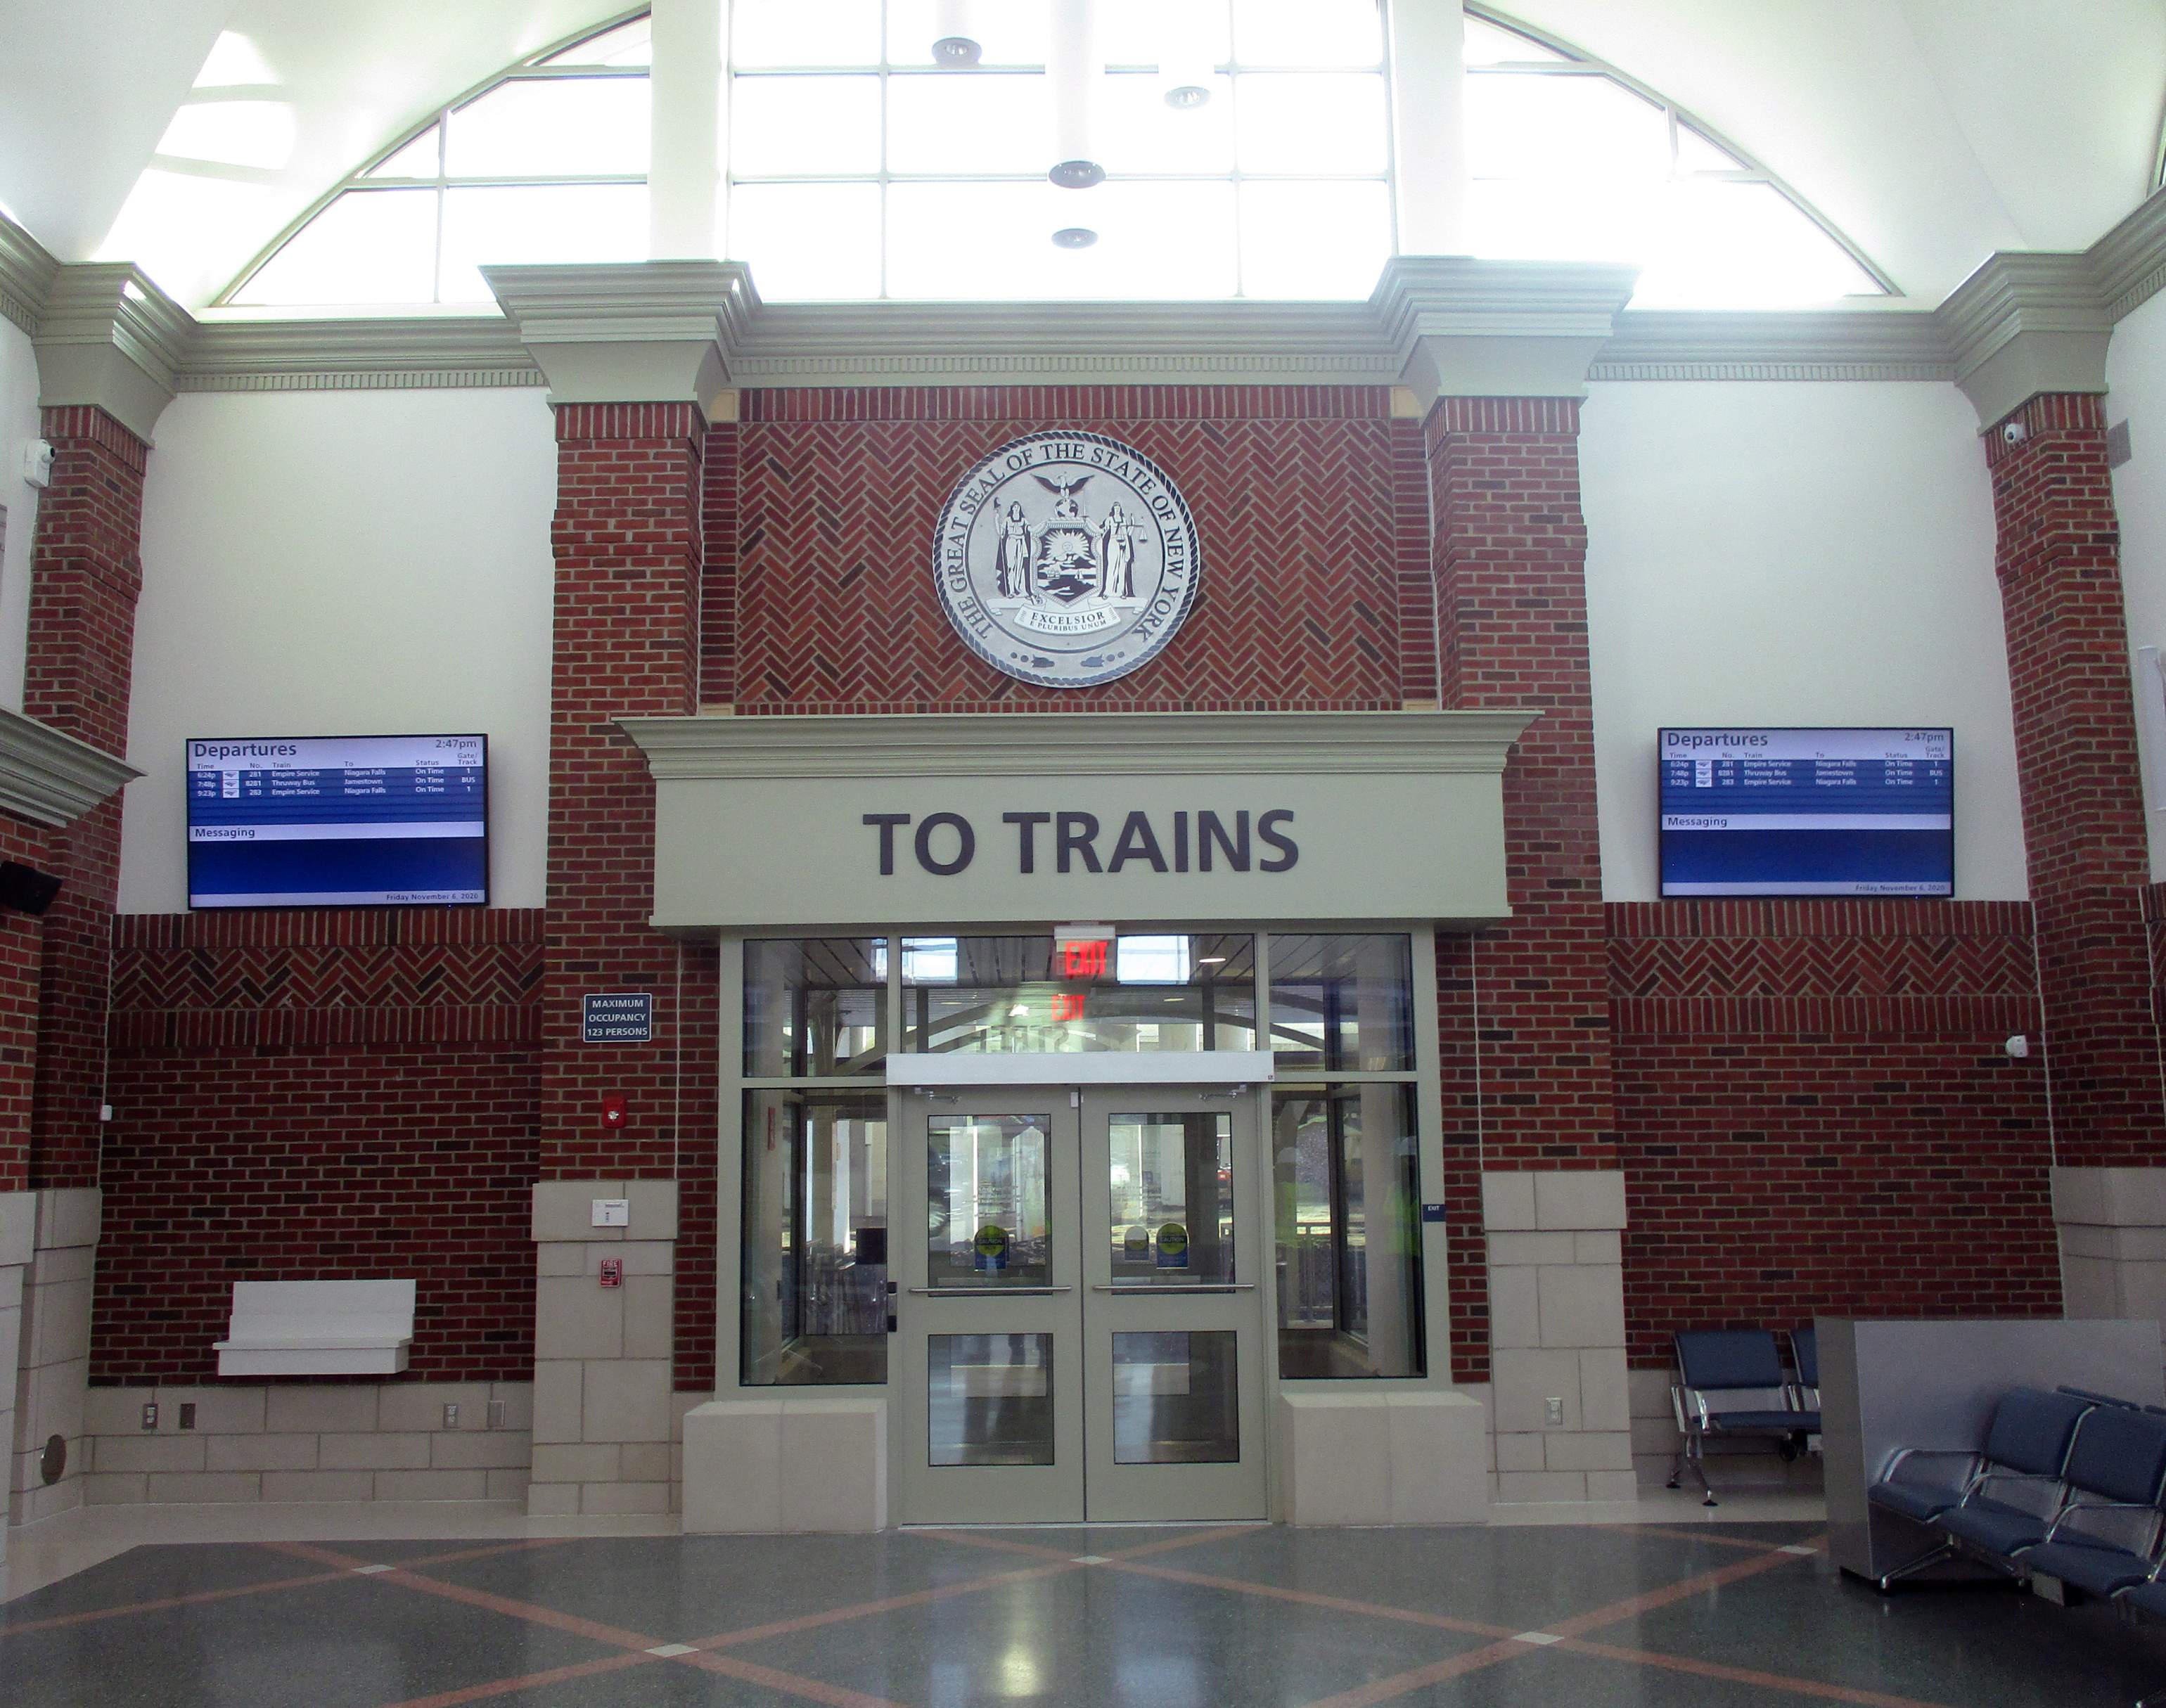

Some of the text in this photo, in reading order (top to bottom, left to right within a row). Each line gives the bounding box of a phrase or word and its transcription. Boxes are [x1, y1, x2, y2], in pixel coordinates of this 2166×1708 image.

[948, 443, 1185, 643] THE GREAT SEAL OF THE STATE OF NEW YORK
[1032, 611, 1104, 624] EXCELSIOR
[1038, 622, 1078, 631] PLURIBUS
[1082, 619, 1106, 630] UNUM
[1667, 732, 1944, 749] Departures 2:47pm
[195, 739, 477, 760] Departures 2:47pm
[1668, 817, 1727, 828] Messaging
[195, 828, 255, 838] Messaging
[862, 809, 1299, 875] TO TRAINS
[1065, 940, 1109, 976] EXIT
[592, 999, 643, 1008] MAXIMUM
[1051, 994, 1086, 1022] EXIT
[589, 1013, 646, 1022] OCCUPANCY
[587, 1027, 648, 1036] 123 PERSONS
